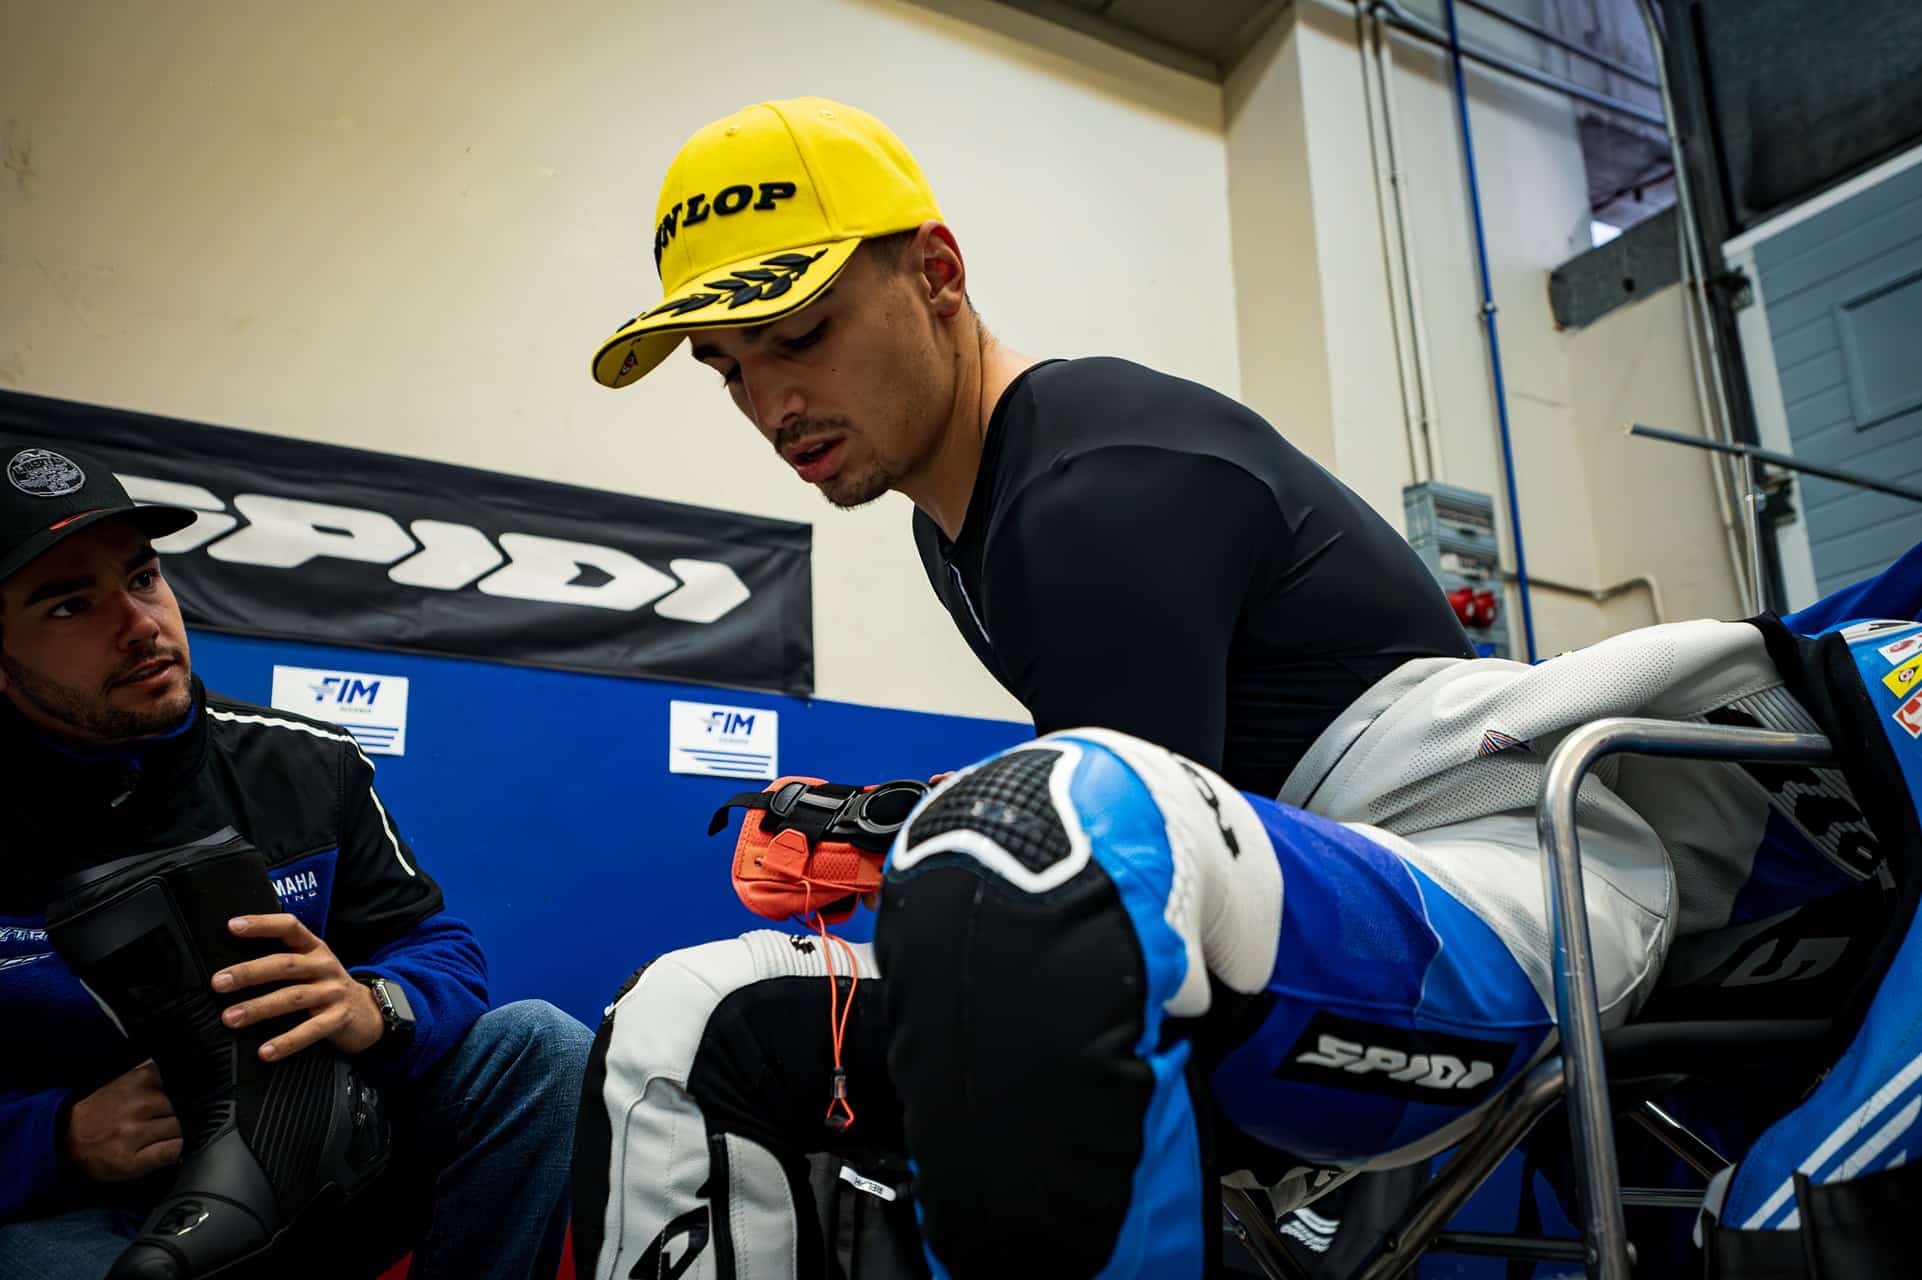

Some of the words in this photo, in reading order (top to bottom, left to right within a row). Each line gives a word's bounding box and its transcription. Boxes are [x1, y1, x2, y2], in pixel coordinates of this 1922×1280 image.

[654, 182, 796, 266] NLOP
[314, 677, 381, 705] FIM
[706, 711, 755, 735] FIM
[272, 871, 317, 897] MAHA
[1296, 1034, 1494, 1088] SPIDI
